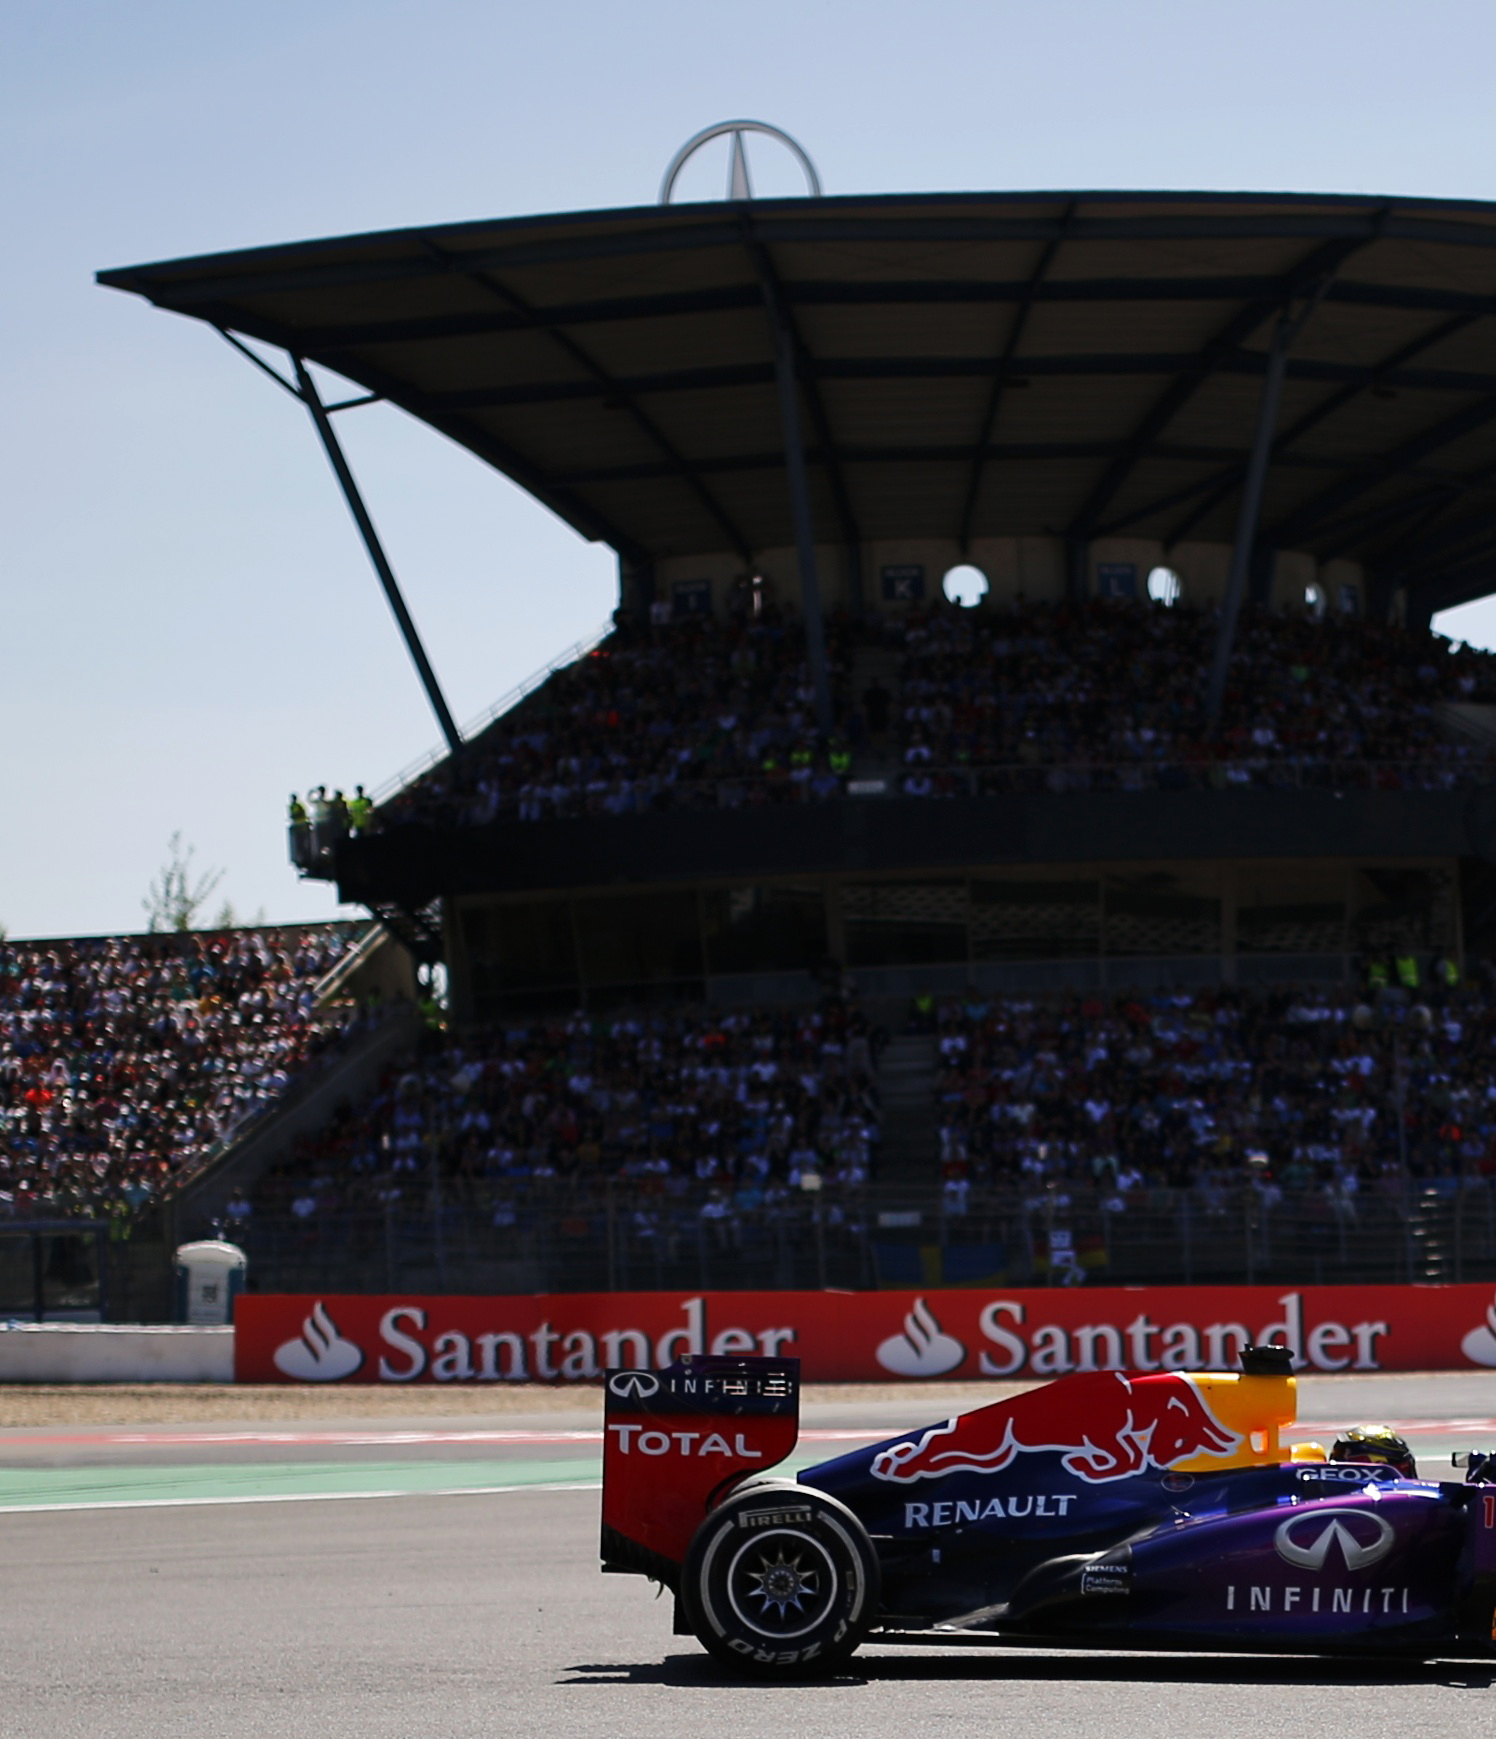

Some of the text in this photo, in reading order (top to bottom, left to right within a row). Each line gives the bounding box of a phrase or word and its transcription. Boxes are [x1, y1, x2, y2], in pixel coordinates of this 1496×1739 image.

[378, 1297, 794, 1383] Santander
[979, 1292, 1388, 1376] Santander
[608, 1424, 763, 1458] TOTAL
[1296, 1467, 1383, 1482] GEOX
[738, 1505, 813, 1528] PIRELLI
[904, 1495, 1077, 1528] RENAULT
[1483, 1495, 1495, 1529] 1
[1084, 1565, 1128, 1573] SIEMENS
[1227, 1586, 1408, 1613] INFINITI
[728, 1637, 824, 1666] ZERO
